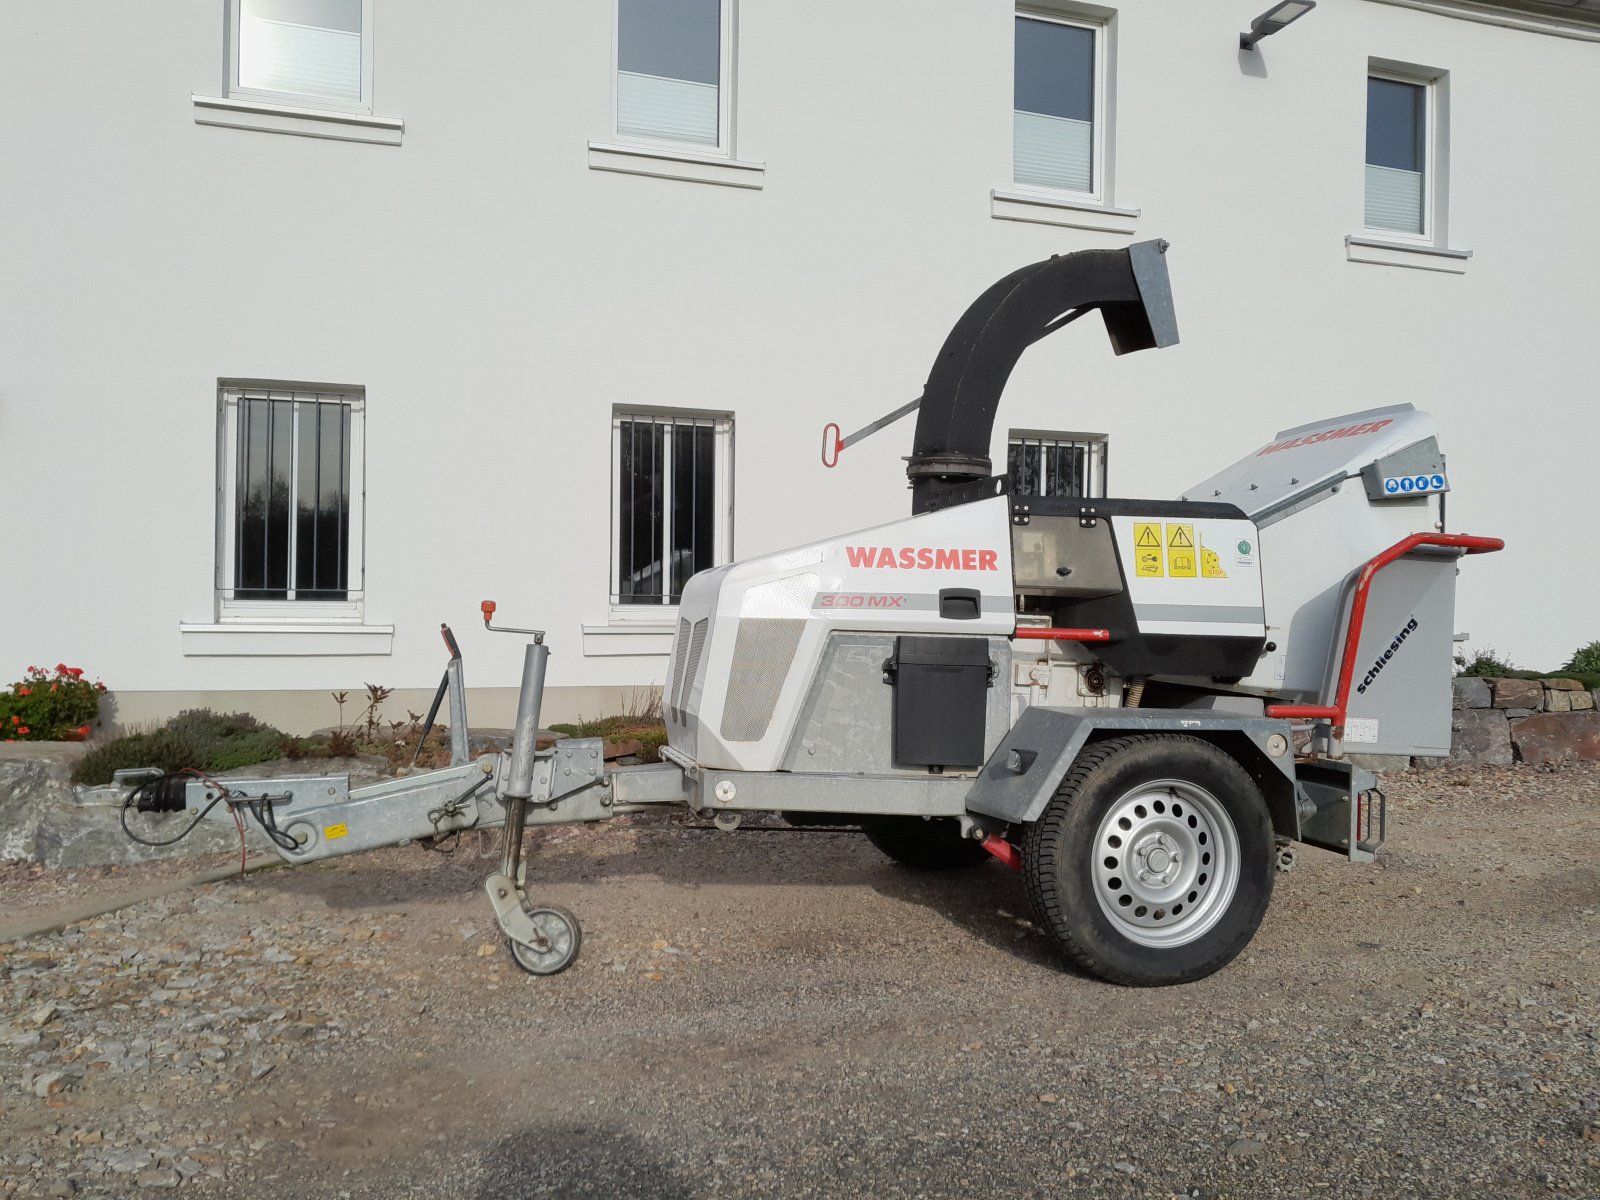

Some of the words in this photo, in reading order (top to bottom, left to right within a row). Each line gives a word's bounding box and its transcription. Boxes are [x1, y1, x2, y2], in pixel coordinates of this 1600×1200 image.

[1256, 419, 1394, 457] WASSMER
[845, 546, 999, 571] WASSMER
[820, 595, 865, 608] 300
[867, 595, 904, 608] MX
[1357, 617, 1419, 694] schliesing
